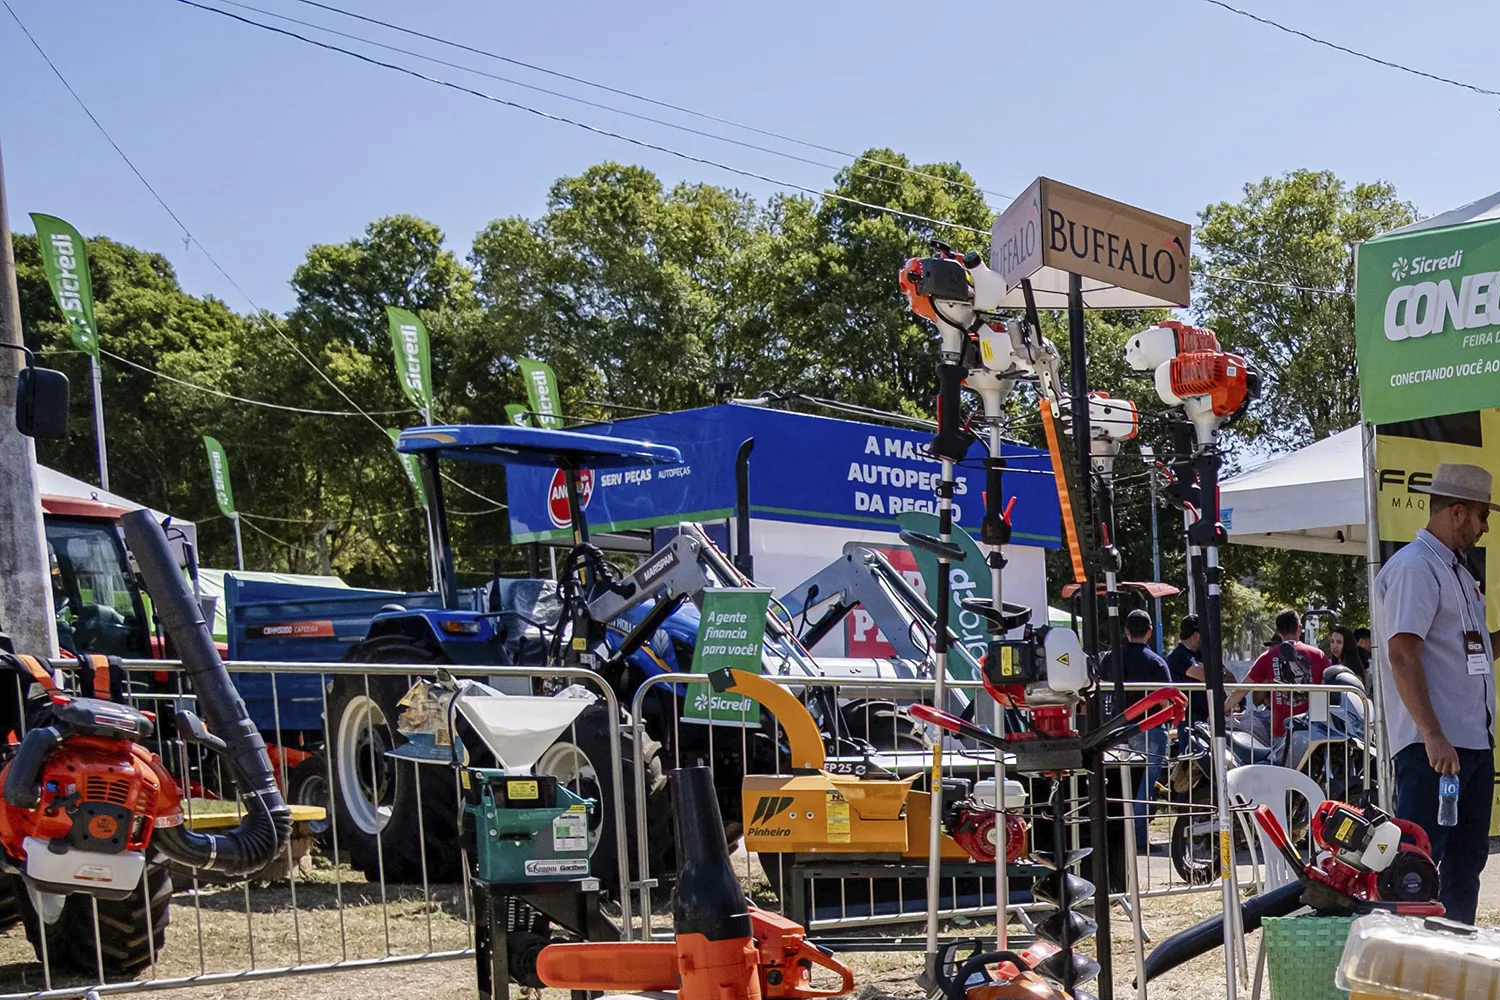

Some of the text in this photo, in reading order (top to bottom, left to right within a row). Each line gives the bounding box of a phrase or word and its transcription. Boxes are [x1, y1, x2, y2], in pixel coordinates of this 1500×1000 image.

[1048, 208, 1176, 285] BUFFALO
[1410, 250, 1463, 275] Sicredi
[50, 233, 83, 313] Sicredi
[1463, 333, 1493, 348] FEIRA
[400, 325, 422, 391] Sicredi
[1390, 366, 1453, 387] CONECTANDO
[1456, 359, 1483, 377] VOCÊ
[1484, 360, 1500, 373] AO
[865, 435, 880, 455] A
[601, 468, 652, 487] SERV PEÇAS
[1379, 469, 1433, 494] FE
[855, 491, 884, 513] DA
[643, 552, 674, 582] MARISPAN
[707, 611, 747, 625] A gente
[704, 627, 747, 640] financia
[702, 644, 758, 656] para você!
[710, 697, 751, 711] Sicredi
[838, 764, 852, 773] 25
[747, 828, 792, 837] Pinheiro
